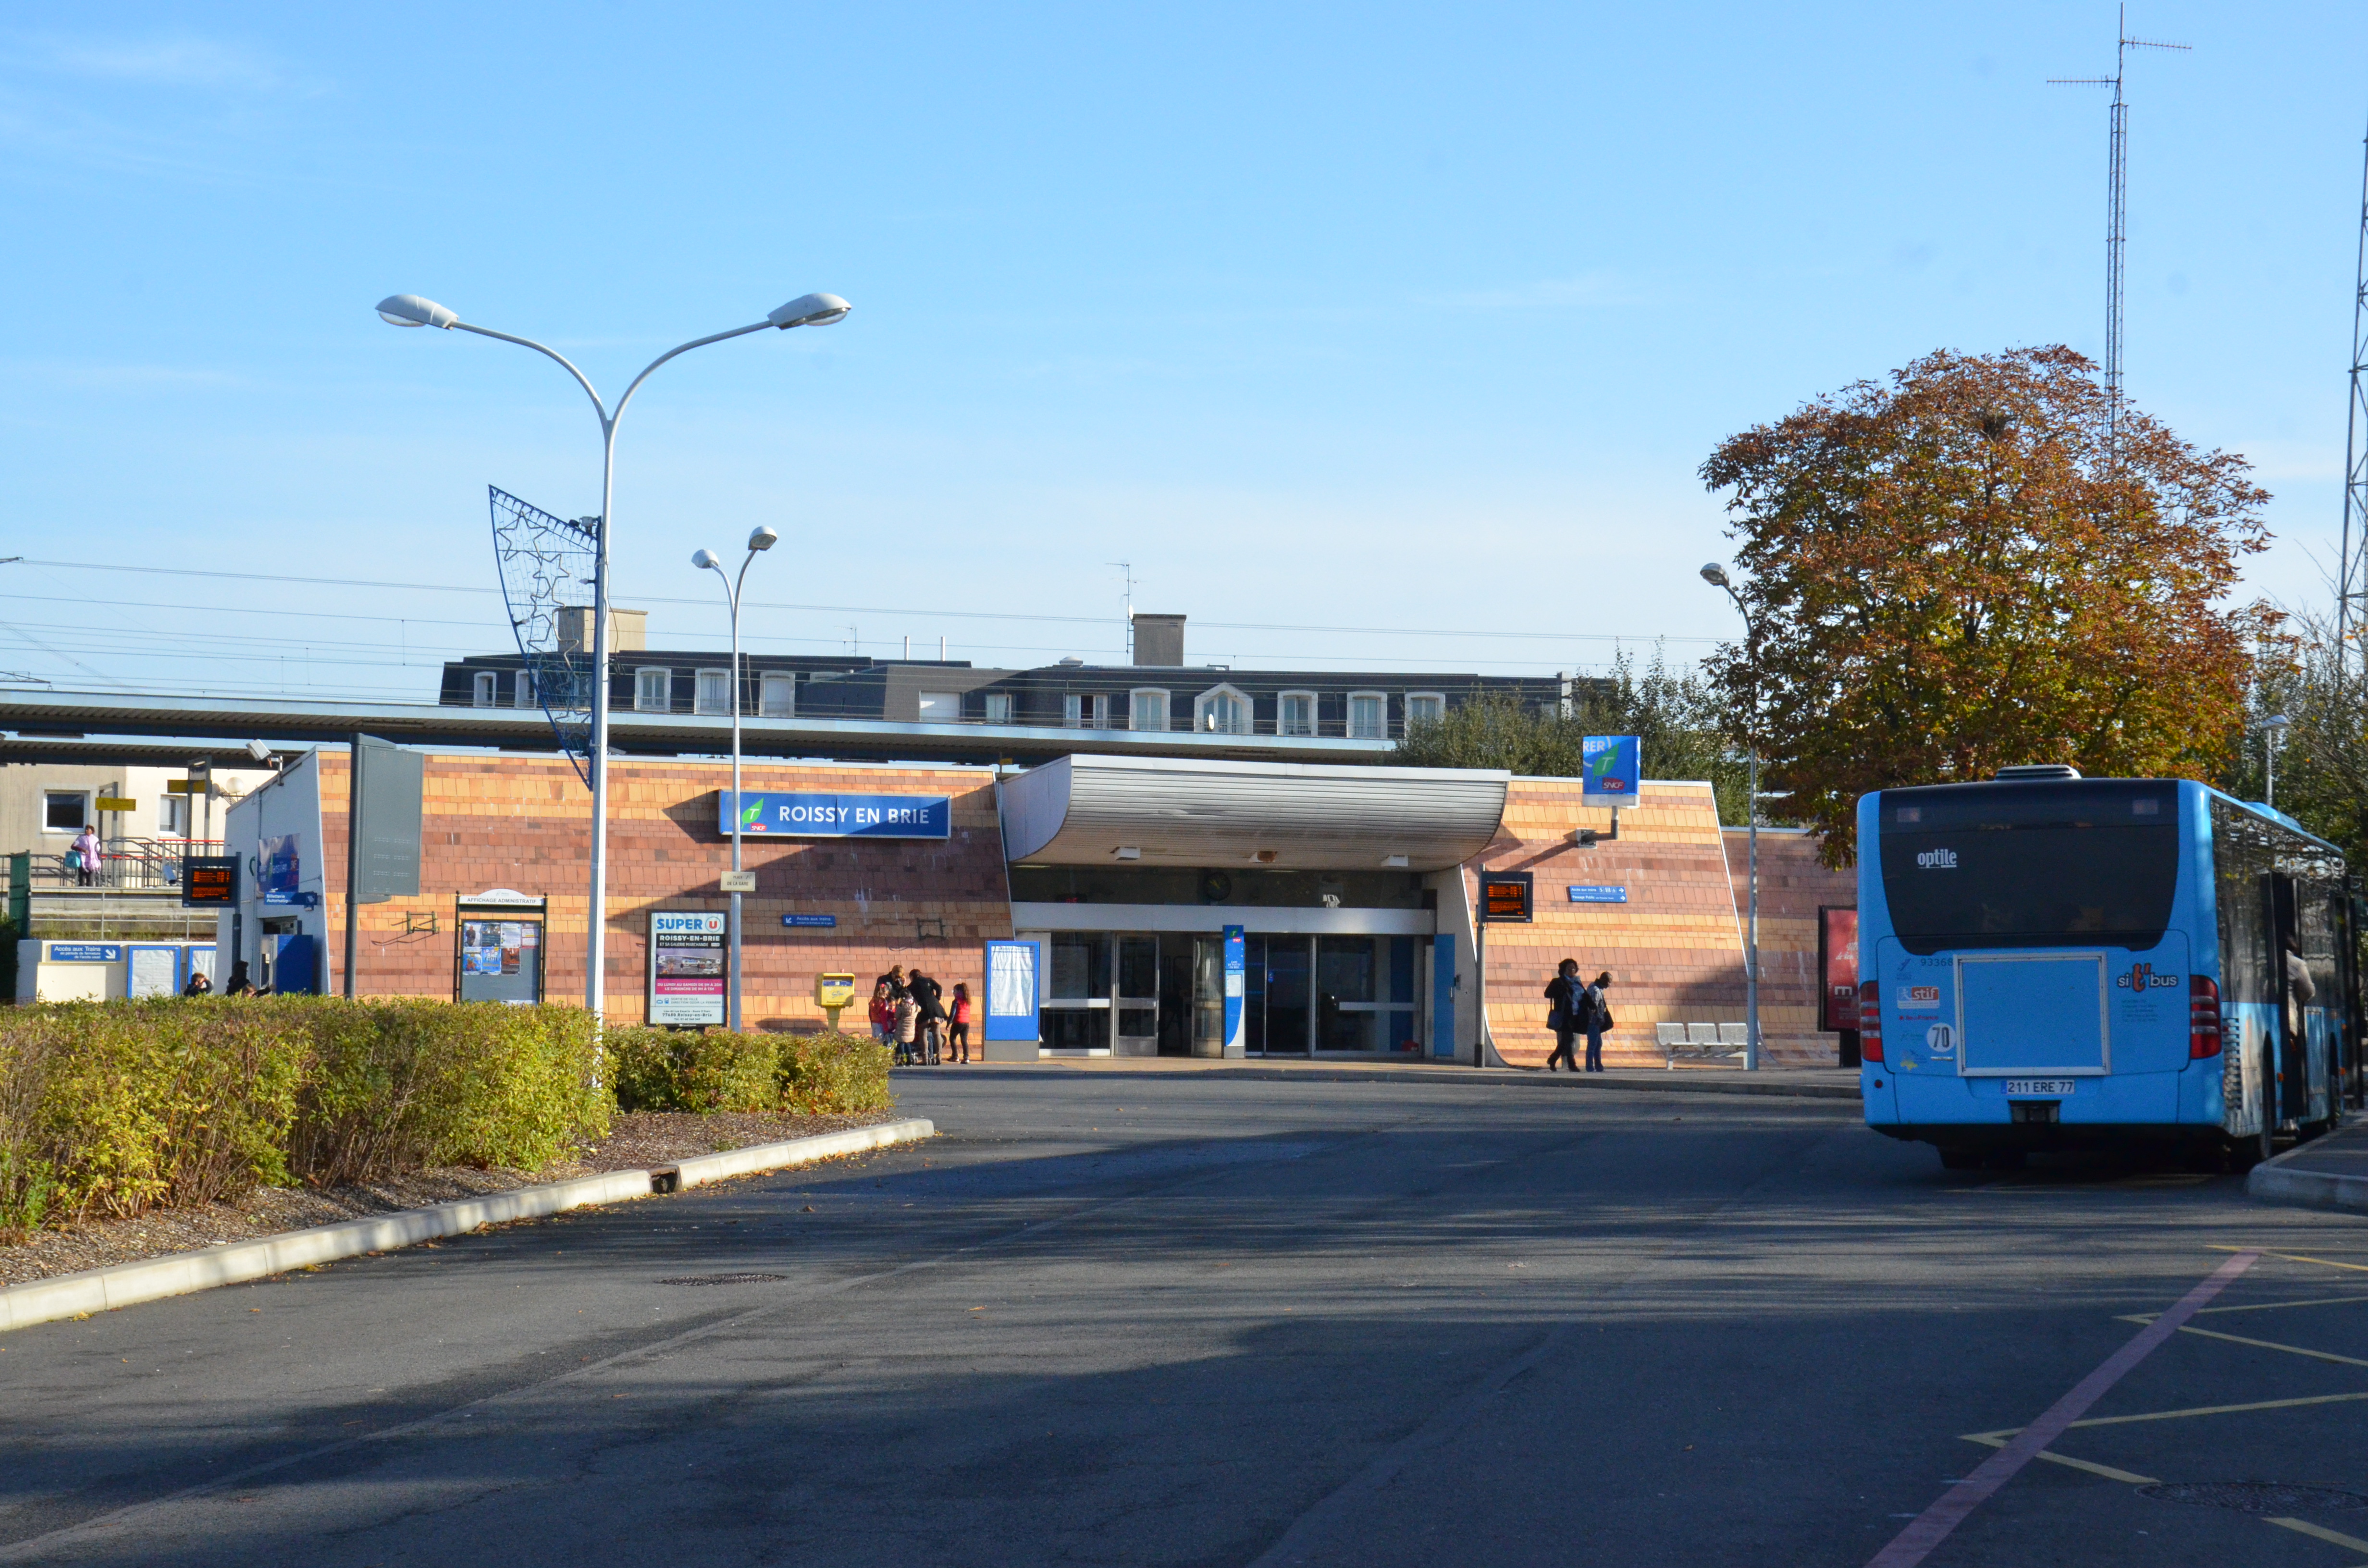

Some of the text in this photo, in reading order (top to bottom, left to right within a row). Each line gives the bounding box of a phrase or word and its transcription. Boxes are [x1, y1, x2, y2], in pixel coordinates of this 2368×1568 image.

[1583, 741, 1605, 752] RER
[1602, 757, 1615, 771] T
[750, 808, 760, 820] T
[779, 806, 929, 824] ROISSY EN BRIE
[1917, 849, 1957, 868] optile
[656, 919, 717, 930] SUPER U
[1920, 958, 1953, 967] 93368
[1912, 987, 1939, 1000] stif
[1932, 1027, 1950, 1048] 70
[2008, 1082, 2073, 1092] 211 ERE 77
